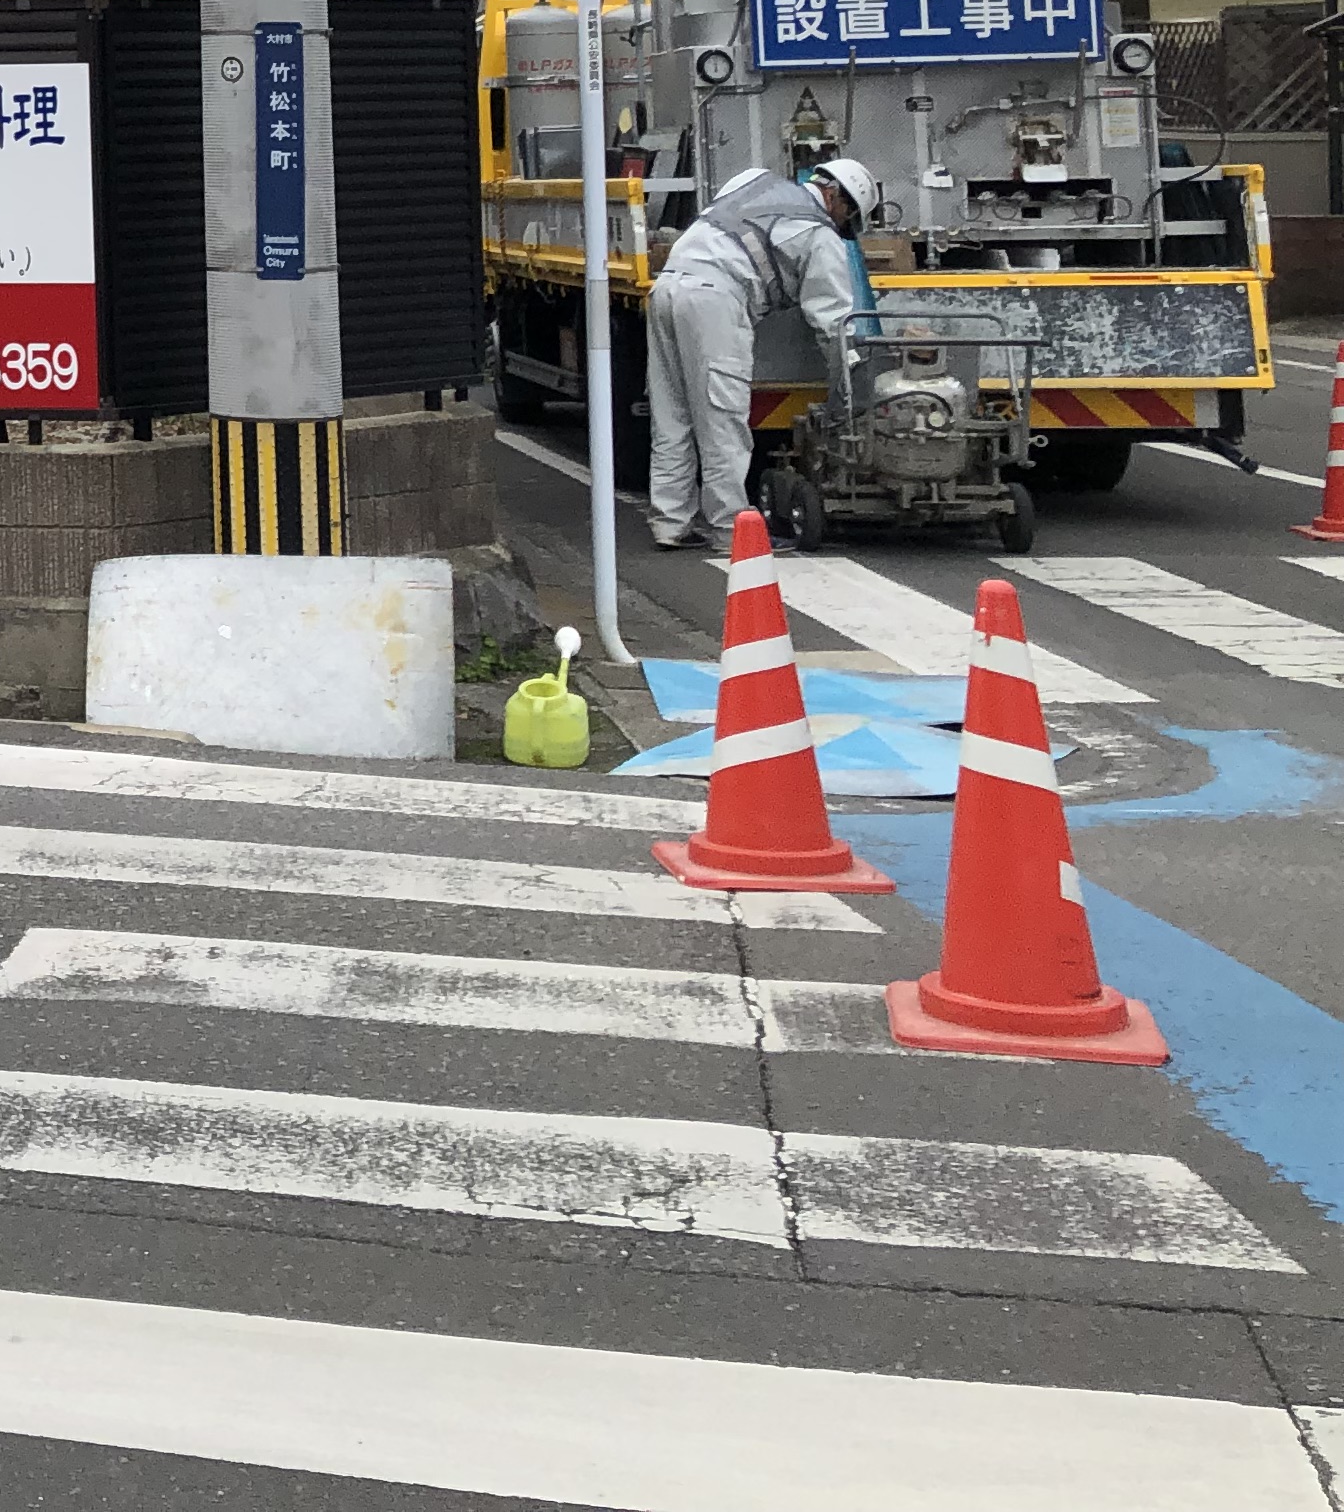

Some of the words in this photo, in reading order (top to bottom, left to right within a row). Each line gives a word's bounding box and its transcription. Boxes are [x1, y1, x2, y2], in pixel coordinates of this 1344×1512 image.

[266, 34, 293, 44] 大村市
[269, 62, 292, 171] 竹松本町
[263, 246, 299, 256] Omura
[266, 258, 285, 268] City
